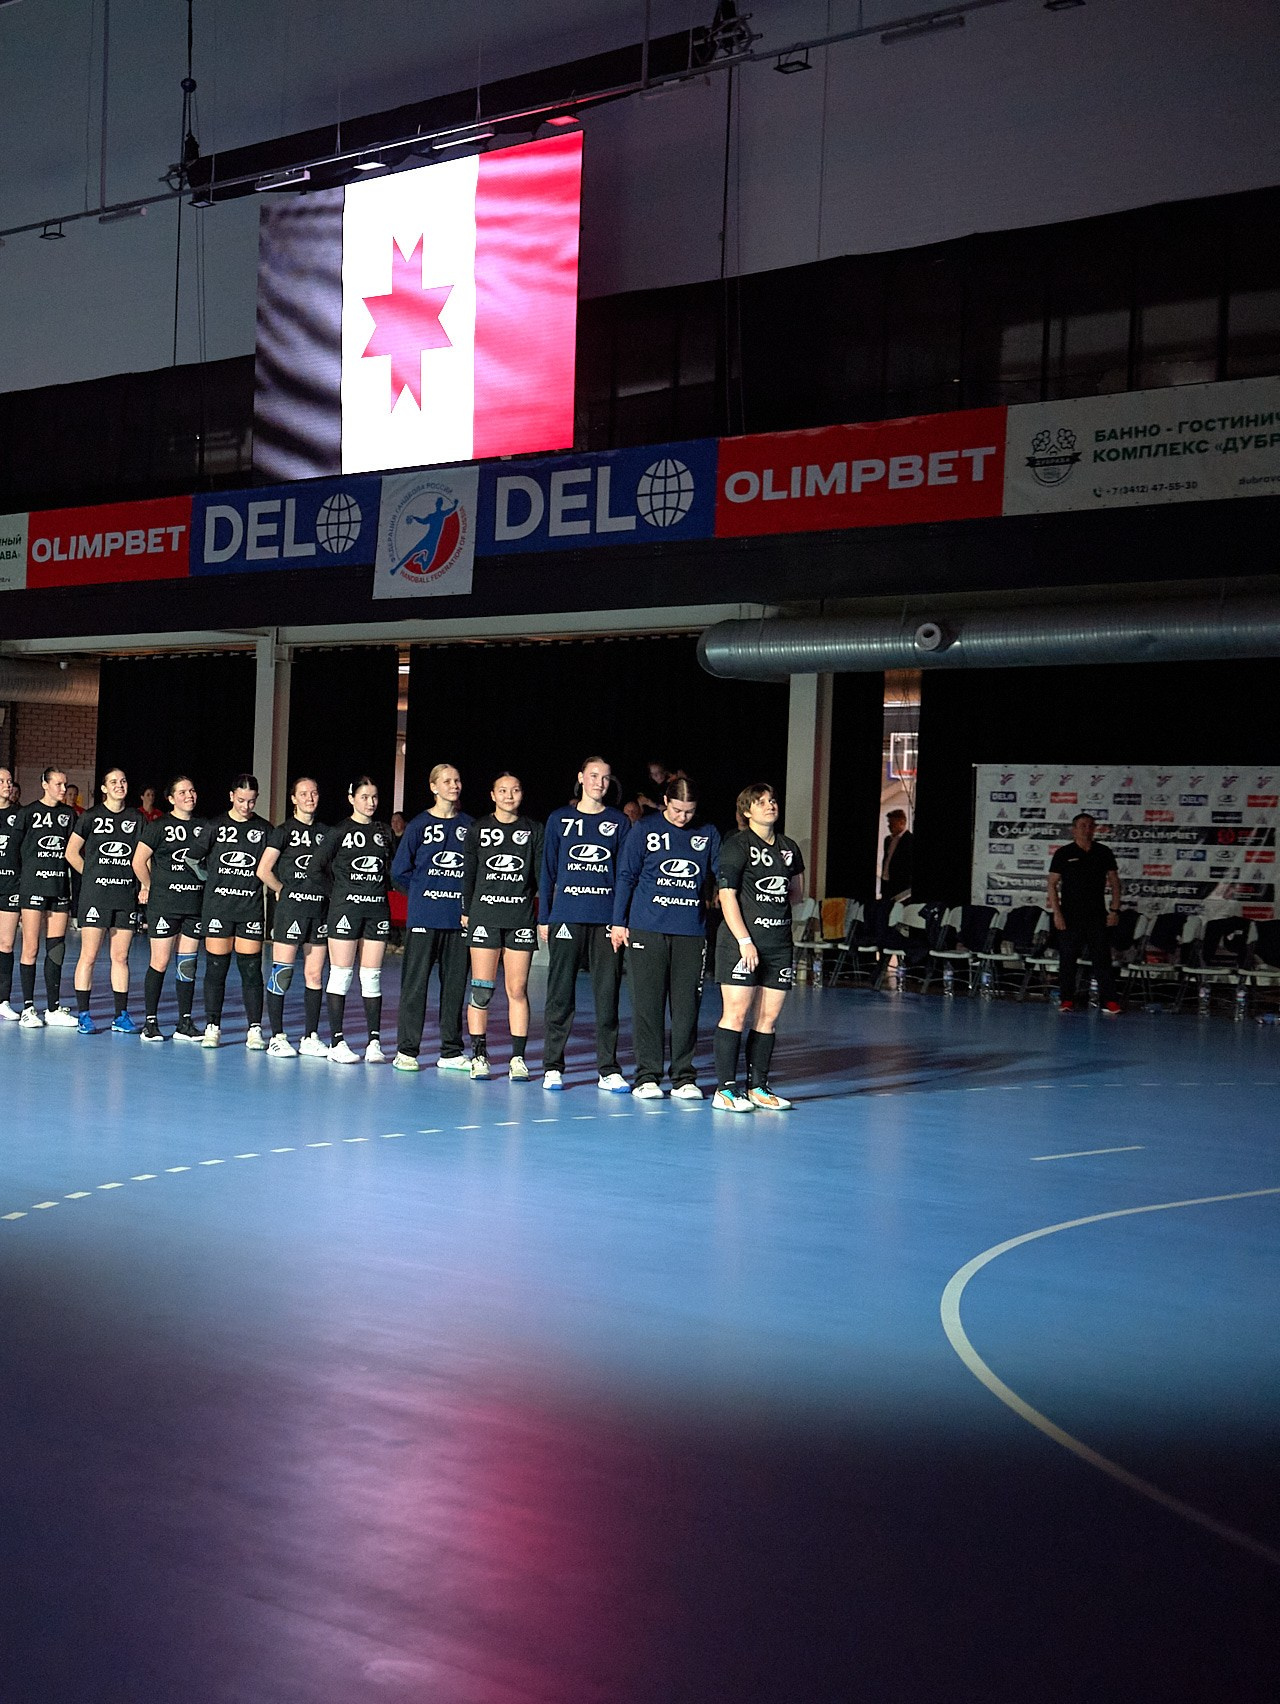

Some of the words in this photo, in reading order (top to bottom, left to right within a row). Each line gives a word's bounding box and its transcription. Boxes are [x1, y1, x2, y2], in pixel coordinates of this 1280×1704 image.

[1094, 423, 1161, 443] БАННО
[1093, 439, 1210, 463] КОМПЛЕКС
[724, 446, 997, 503] OLIMPBET
[30, 524, 187, 564] OLIMPBET
[32, 812, 54, 829] 24
[93, 817, 115, 834] 25
[561, 818, 584, 837] 71
[164, 825, 187, 842] 30
[216, 826, 238, 843] 32
[289, 829, 311, 847] 34
[341, 831, 366, 849] 40
[422, 823, 445, 845] 55
[479, 828, 504, 847] 59
[1011, 827, 1062, 836] OLIMPBET
[1141, 830, 1199, 841] OLIMPBET
[646, 832, 671, 852] 81
[99, 858, 131, 867] ИЖ-ЛАДА
[749, 846, 774, 867] 96
[218, 867, 255, 878] ИЖ-ЛАДА
[567, 863, 609, 873] ИЖ-ЛАДА
[95, 877, 132, 887] AQUALITY
[485, 872, 524, 883] ИЖ-ЛАДА
[214, 886, 256, 897] AQUALITY
[563, 885, 611, 896] AQUALITY
[1142, 884, 1199, 895] OLIMPBET
[479, 893, 527, 905] AQUALITY
[652, 895, 700, 907] AQUALITY
